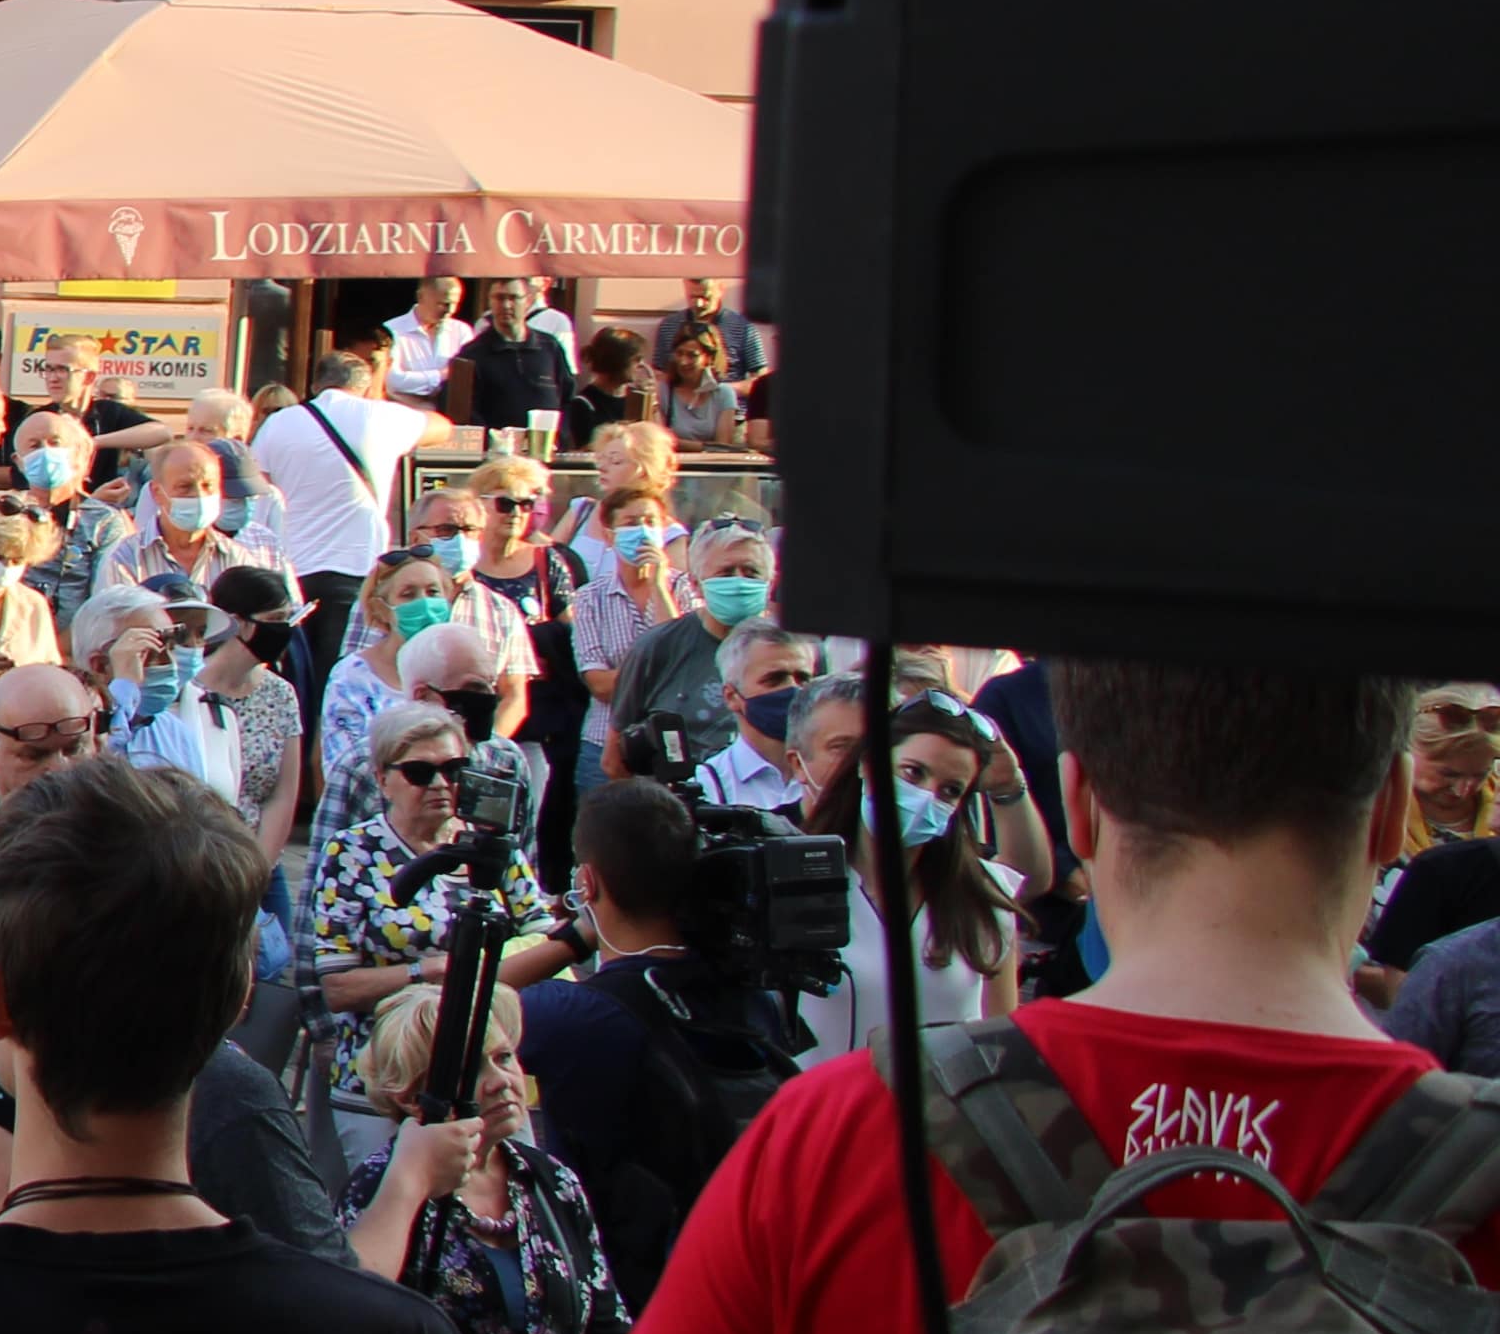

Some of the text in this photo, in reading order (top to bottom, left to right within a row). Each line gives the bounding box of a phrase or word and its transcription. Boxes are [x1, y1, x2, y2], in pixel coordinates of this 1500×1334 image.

[210, 208, 744, 262] LODZIARNIA CARMELITO
[120, 329, 201, 356] STAR
[150, 361, 208, 378] KOMIS
